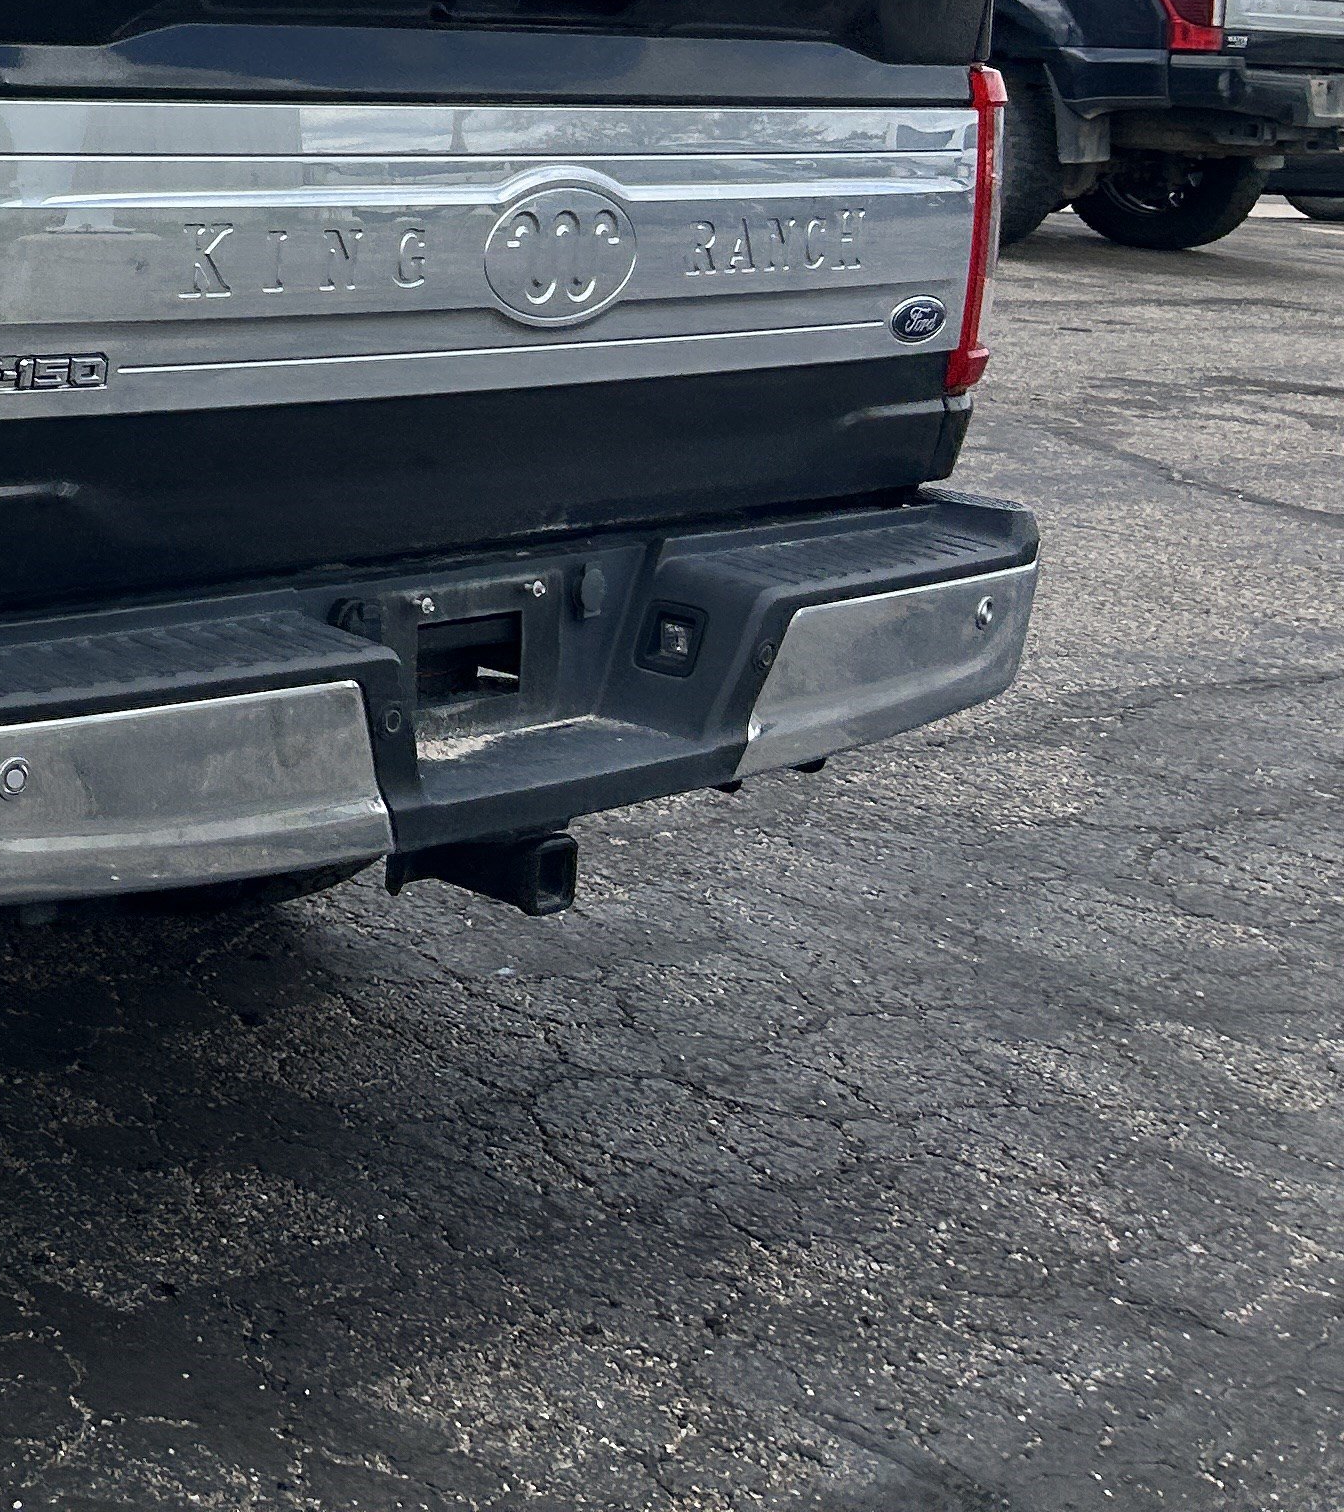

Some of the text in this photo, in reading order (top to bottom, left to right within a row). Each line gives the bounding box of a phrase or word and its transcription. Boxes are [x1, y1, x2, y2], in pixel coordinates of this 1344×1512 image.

[177, 207, 867, 299] KING RANCH
[904, 306, 939, 333] Ford
